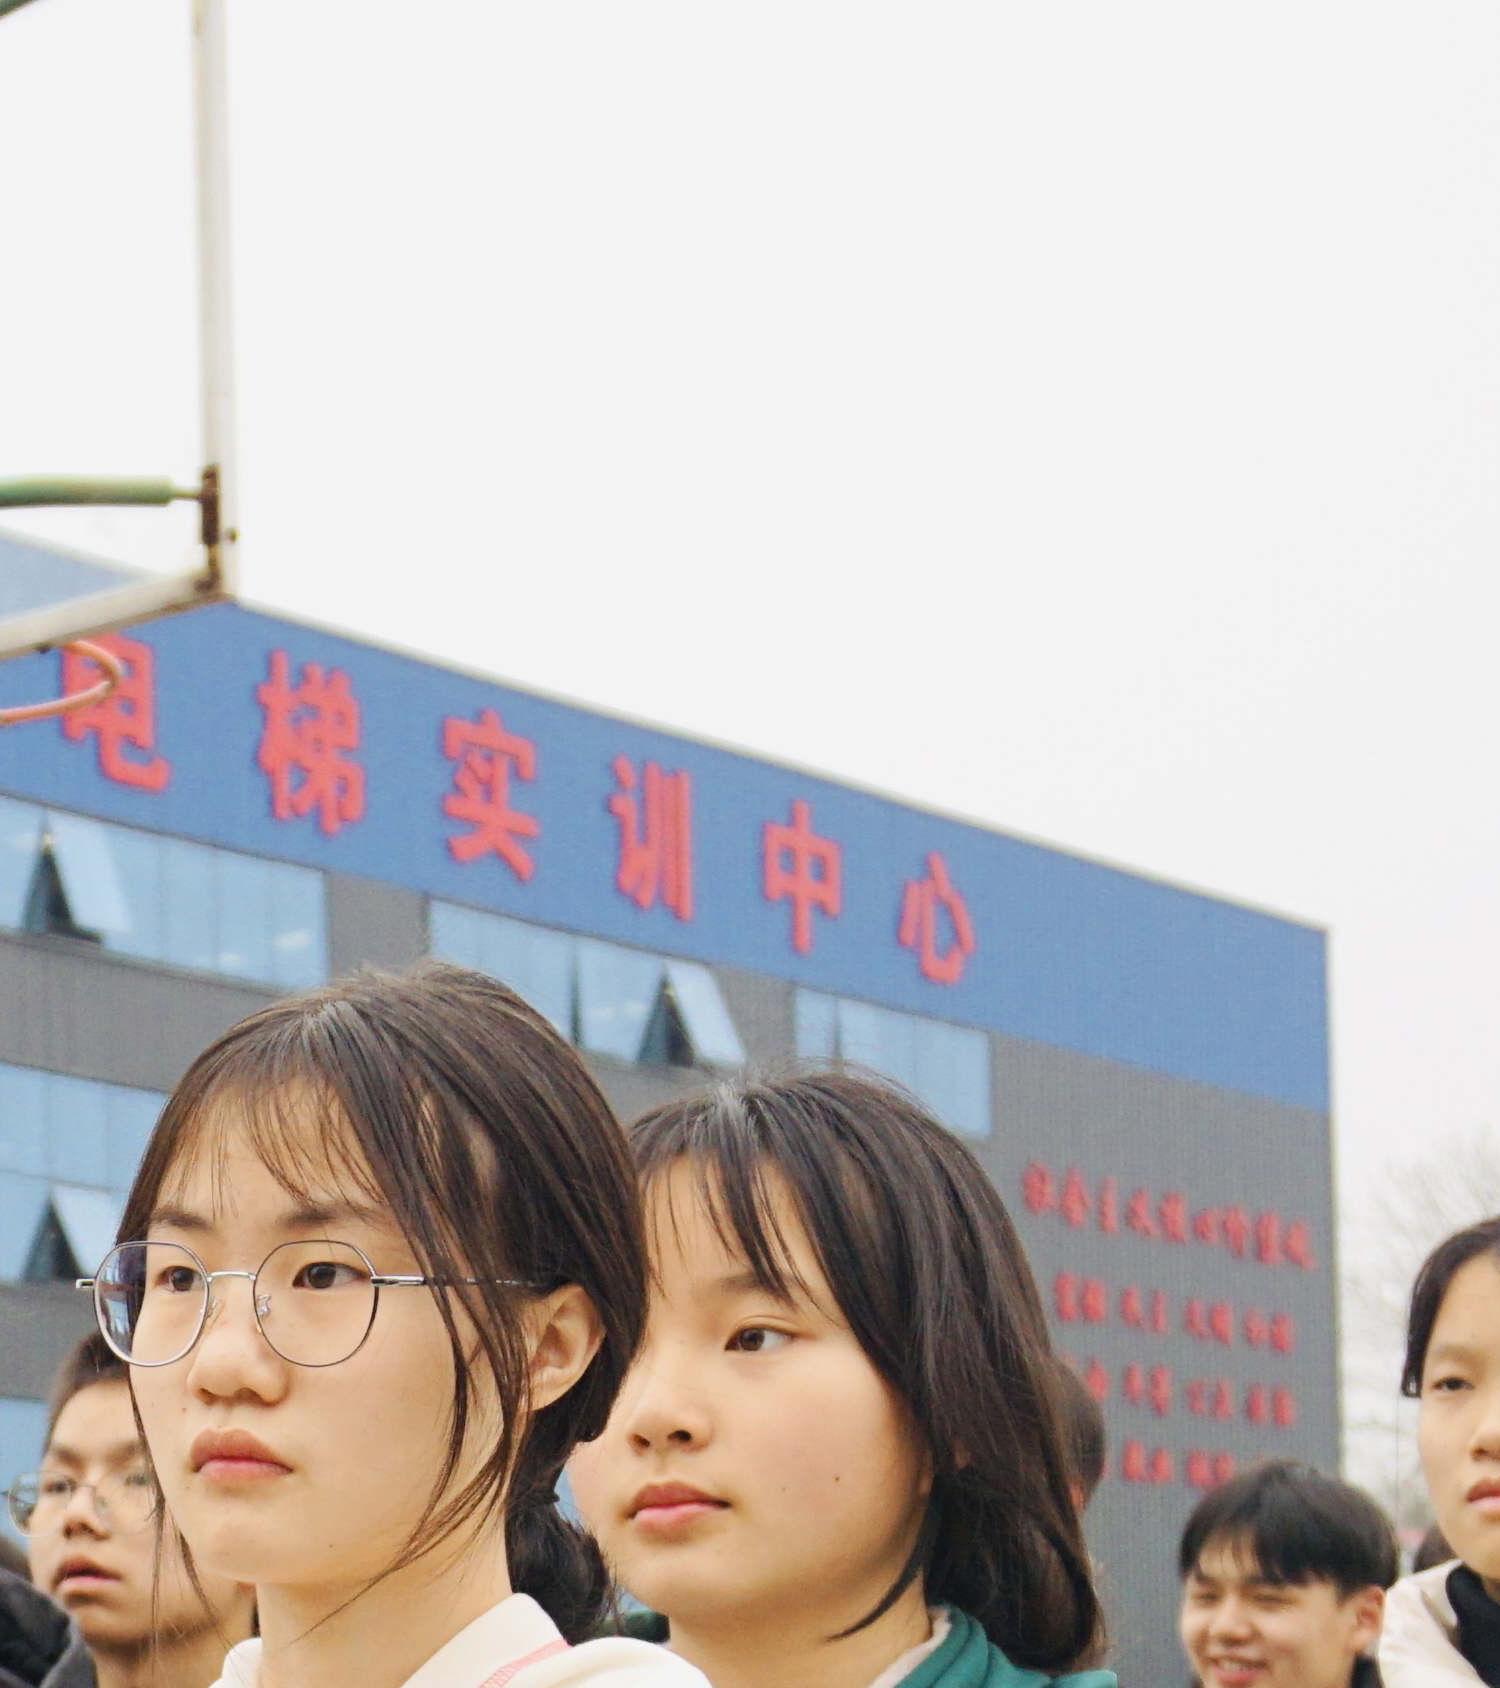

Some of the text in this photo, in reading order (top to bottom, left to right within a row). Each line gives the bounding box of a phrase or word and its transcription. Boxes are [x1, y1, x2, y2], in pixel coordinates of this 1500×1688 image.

[61, 630, 977, 986] 电梯实训中心
